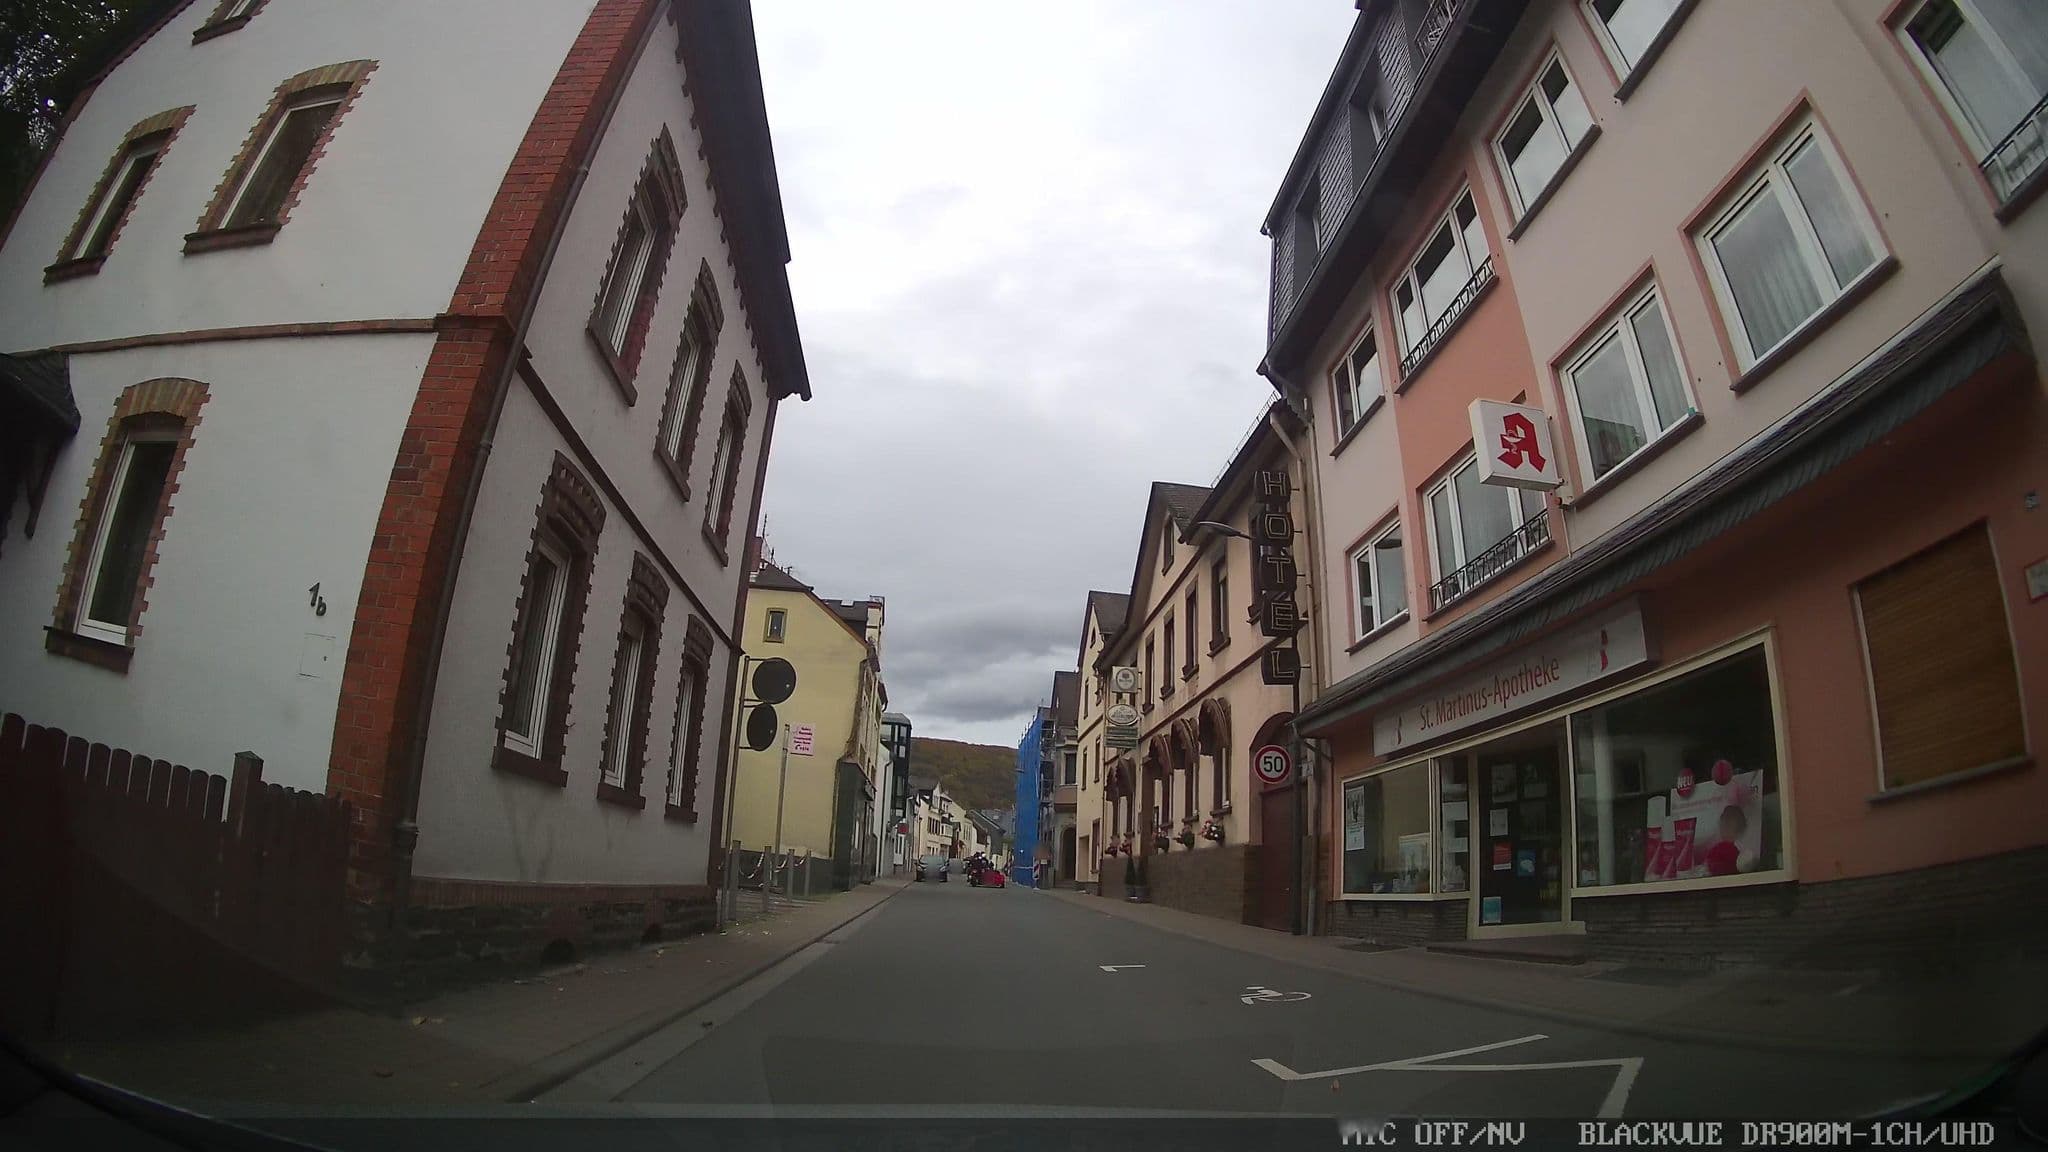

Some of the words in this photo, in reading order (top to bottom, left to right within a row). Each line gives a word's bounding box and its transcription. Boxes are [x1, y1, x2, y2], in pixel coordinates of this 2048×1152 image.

[308, 582, 327, 617] 1b
[1263, 471, 1295, 679] HOTEL
[1420, 704, 1434, 731] St.
[1436, 656, 1560, 726] Martinus-Apotheke
[1263, 755, 1284, 773] 50
